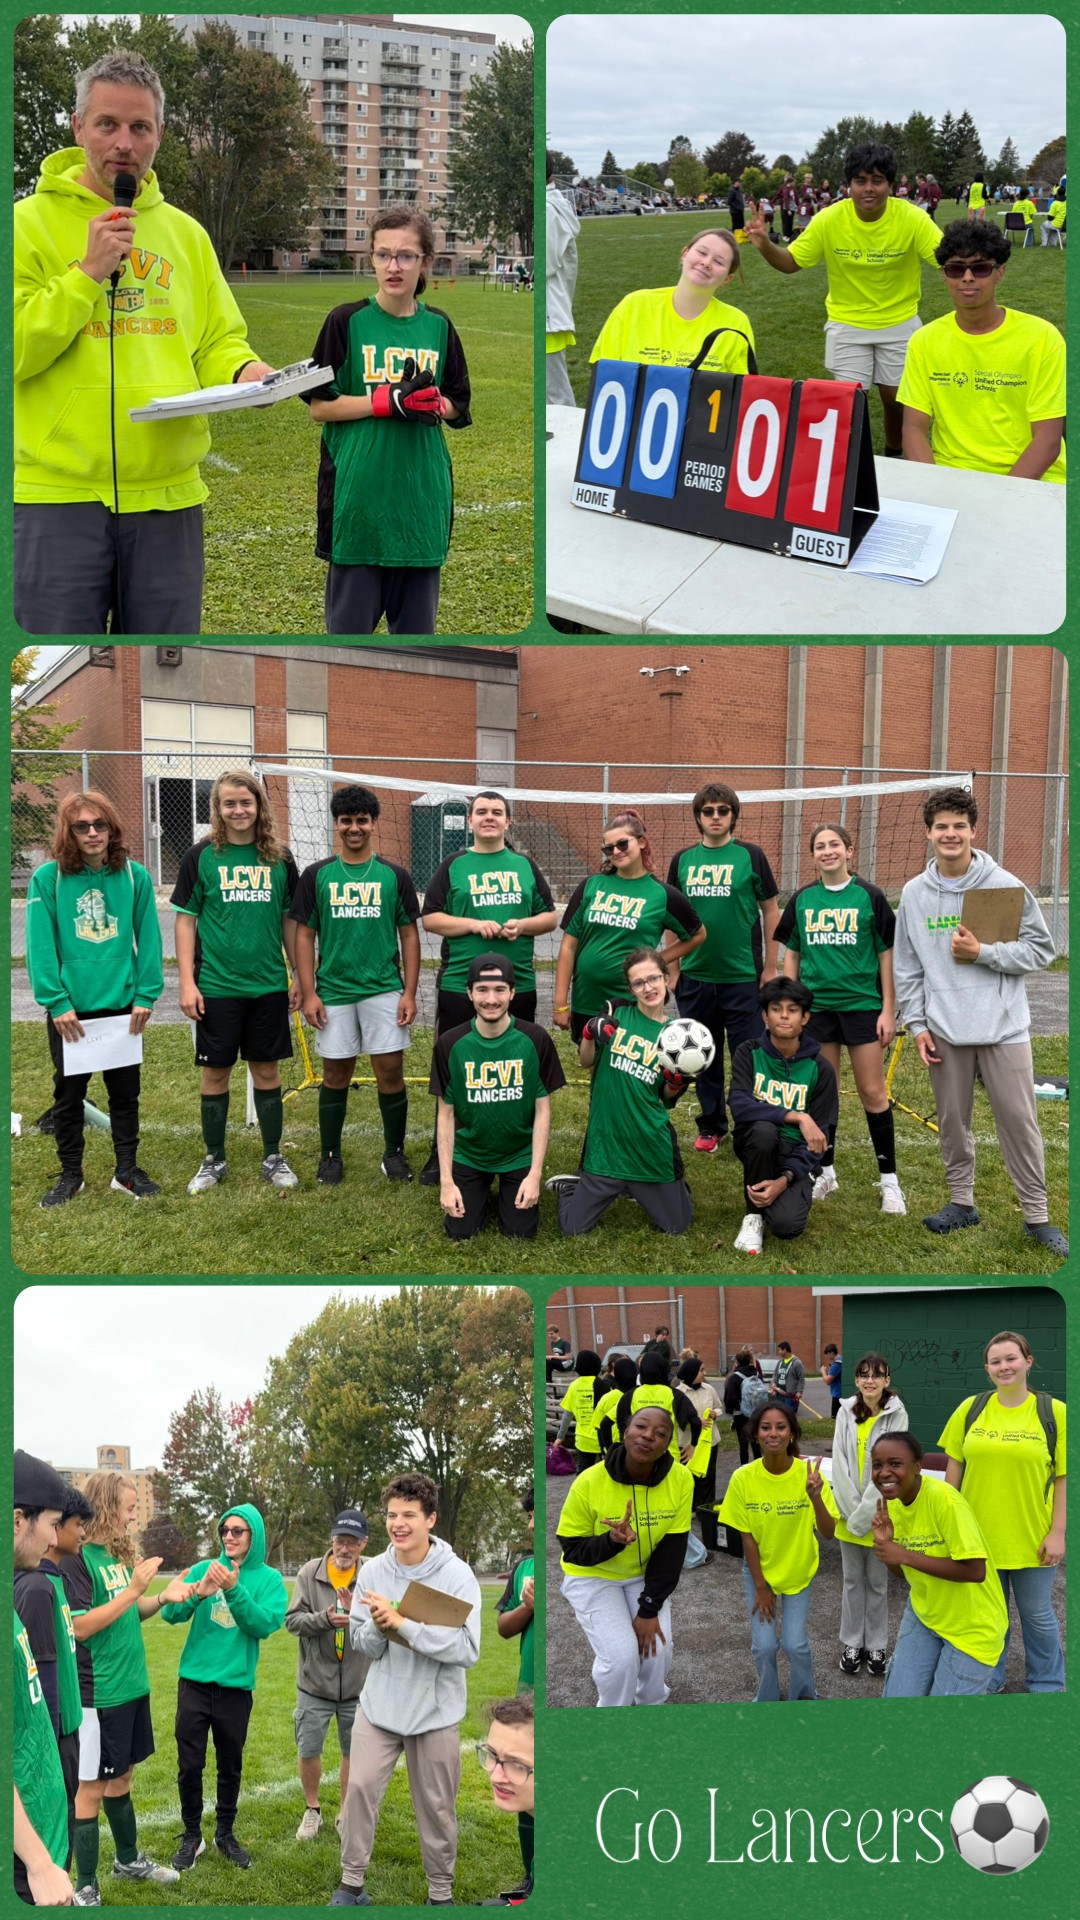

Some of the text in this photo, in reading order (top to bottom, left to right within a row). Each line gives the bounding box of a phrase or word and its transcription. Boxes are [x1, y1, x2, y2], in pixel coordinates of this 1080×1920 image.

[974, 377, 1027, 387] Unified Champion
[993, 371, 1023, 380] Olympics
[974, 384, 997, 392] Schools
[707, 390, 722, 433] 1
[684, 460, 726, 479] PERIOD
[684, 474, 723, 493] GAMES
[576, 488, 610, 507] HOME
[795, 534, 845, 559] GUEST
[218, 865, 272, 890] LCVI
[468, 871, 522, 895] LCVI
[686, 864, 734, 886] LCVI
[222, 890, 271, 902] LANCERS
[329, 882, 382, 906] LCVI
[472, 892, 522, 907] LANCERS
[686, 885, 731, 897] LANCERS
[331, 906, 381, 918] LANCERS
[590, 890, 647, 918] LCVI
[588, 911, 639, 930] LANCERS
[805, 908, 859, 932] LCVI
[806, 932, 857, 945] LANCERS
[465, 1059, 523, 1089] LCVI
[610, 1053, 658, 1085] LANCERS
[467, 1087, 523, 1103] LANCERS
[753, 1072, 808, 1110] LCVI
